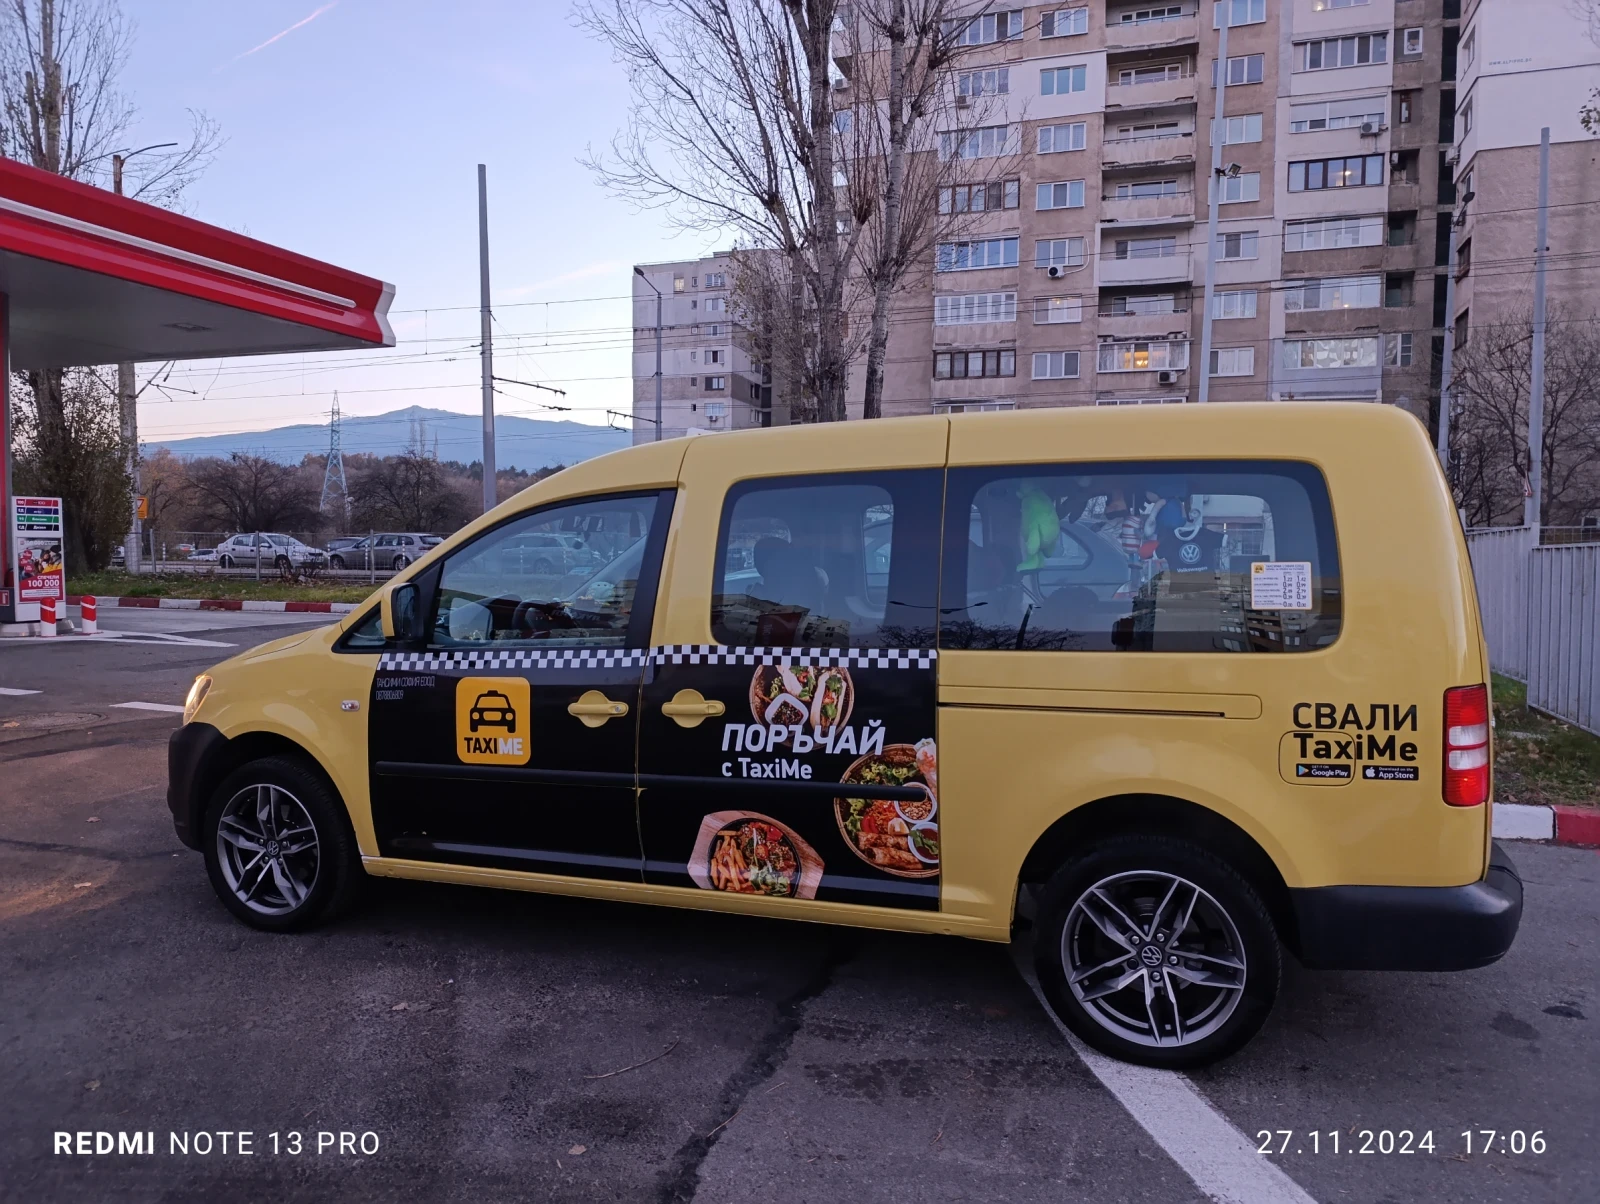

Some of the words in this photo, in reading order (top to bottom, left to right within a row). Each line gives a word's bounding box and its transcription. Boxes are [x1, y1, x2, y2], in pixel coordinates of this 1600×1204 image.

[27, 580, 43, 588] 100
[44, 579, 60, 587] 000
[1292, 702, 1418, 731] СВАЛИ
[463, 736, 523, 755] TAXIME
[721, 718, 886, 755] ПОРЪЧАЙ
[1293, 732, 1418, 762] TaxiMe
[738, 757, 813, 779] TaxiMe
[1311, 769, 1334, 777] Google
[1335, 769, 1348, 777] Play
[1378, 771, 1394, 779] App
[1394, 771, 1414, 779] Store
